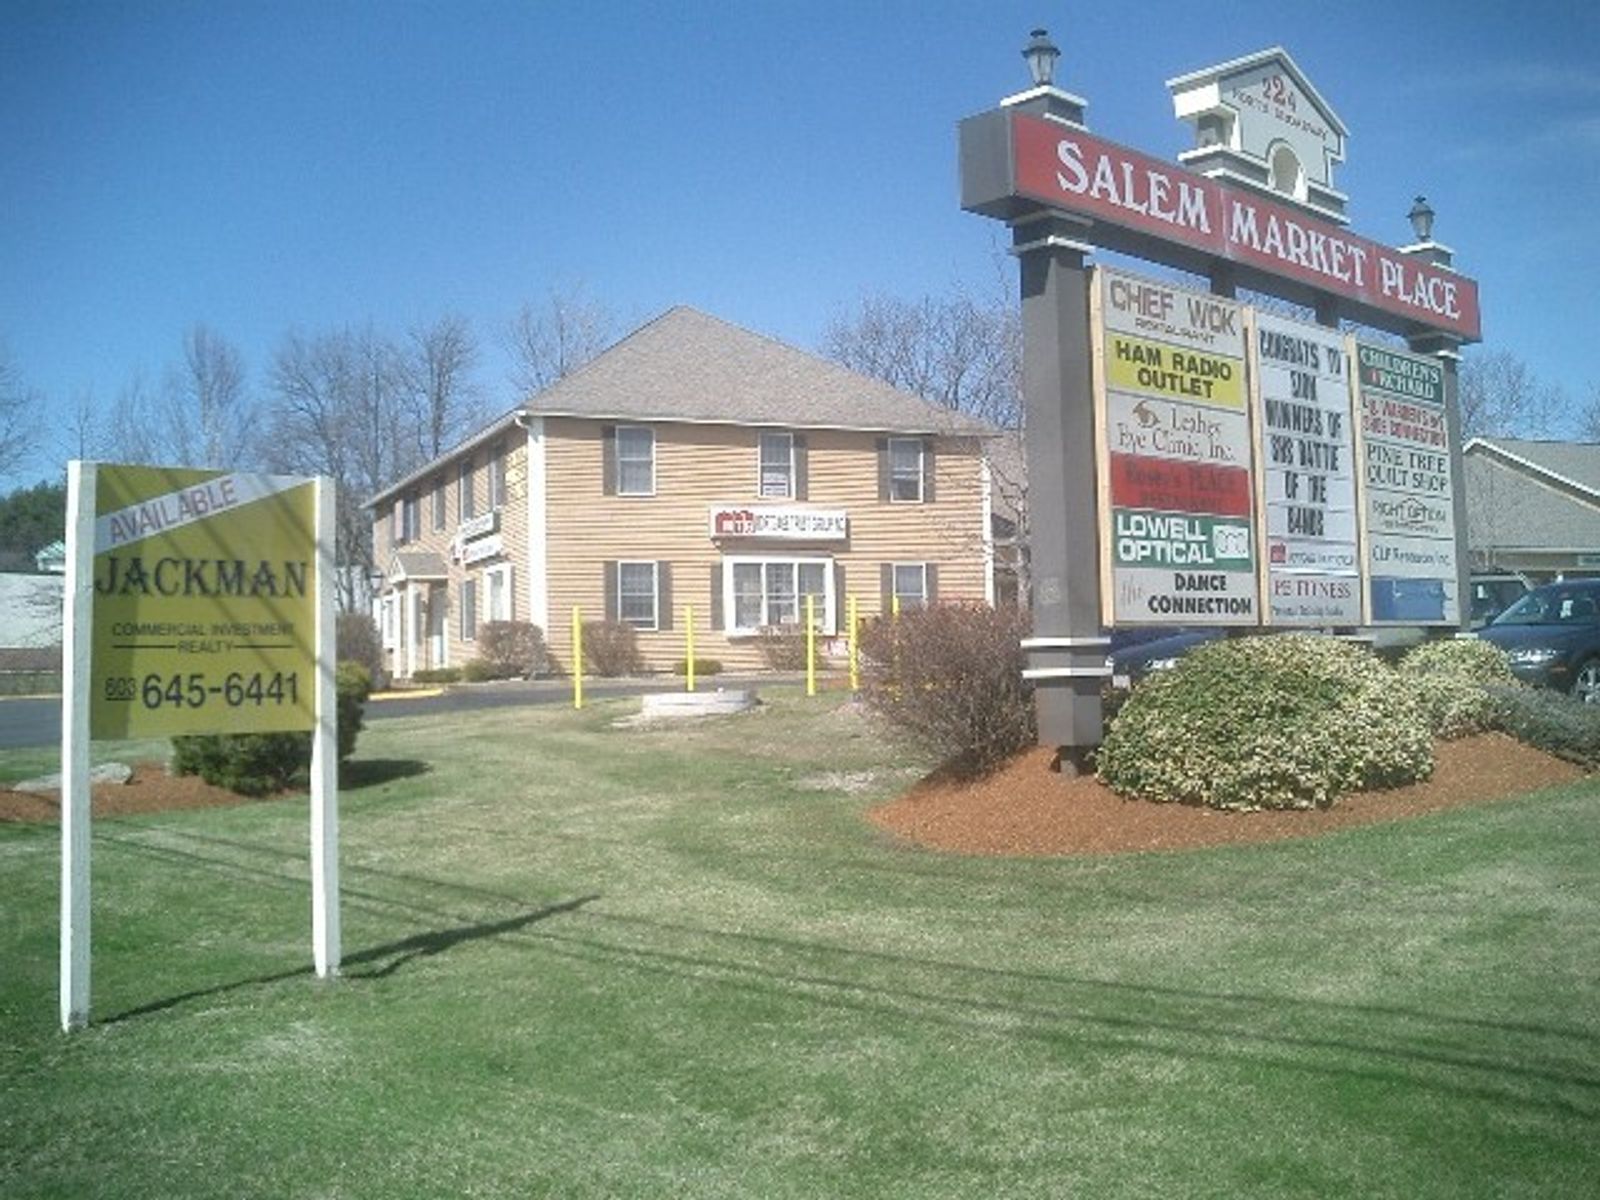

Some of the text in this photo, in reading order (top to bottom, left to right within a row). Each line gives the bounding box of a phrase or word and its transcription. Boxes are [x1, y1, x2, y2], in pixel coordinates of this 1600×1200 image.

[1262, 74, 1297, 113] 224
[1055, 140, 1462, 320] SALEM MARKET PLACE
[1187, 297, 1237, 337] WOK
[1115, 339, 1232, 381] HAM RADIO
[1260, 329, 1320, 370] CONGRATS
[1137, 367, 1215, 399] OUTLET
[1265, 399, 1323, 437] WINNERS
[1367, 442, 1447, 474] PINE TREE
[1284, 470, 1300, 500] OF
[1367, 464, 1449, 493] QUILT SHOP
[109, 479, 237, 545] AVAILABLE
[1117, 514, 1209, 541] LOWELL
[1118, 537, 1214, 564] OPTICAL
[95, 556, 309, 598] JACKMAN
[1174, 572, 1228, 592] DANCE
[1296, 579, 1352, 600] FITNESS
[1148, 595, 1252, 615] CONNECTION
[112, 621, 296, 638] COMMERCIAL INVESTMENT
[176, 639, 235, 655] REALTY
[104, 670, 300, 710] 603 645-6441
